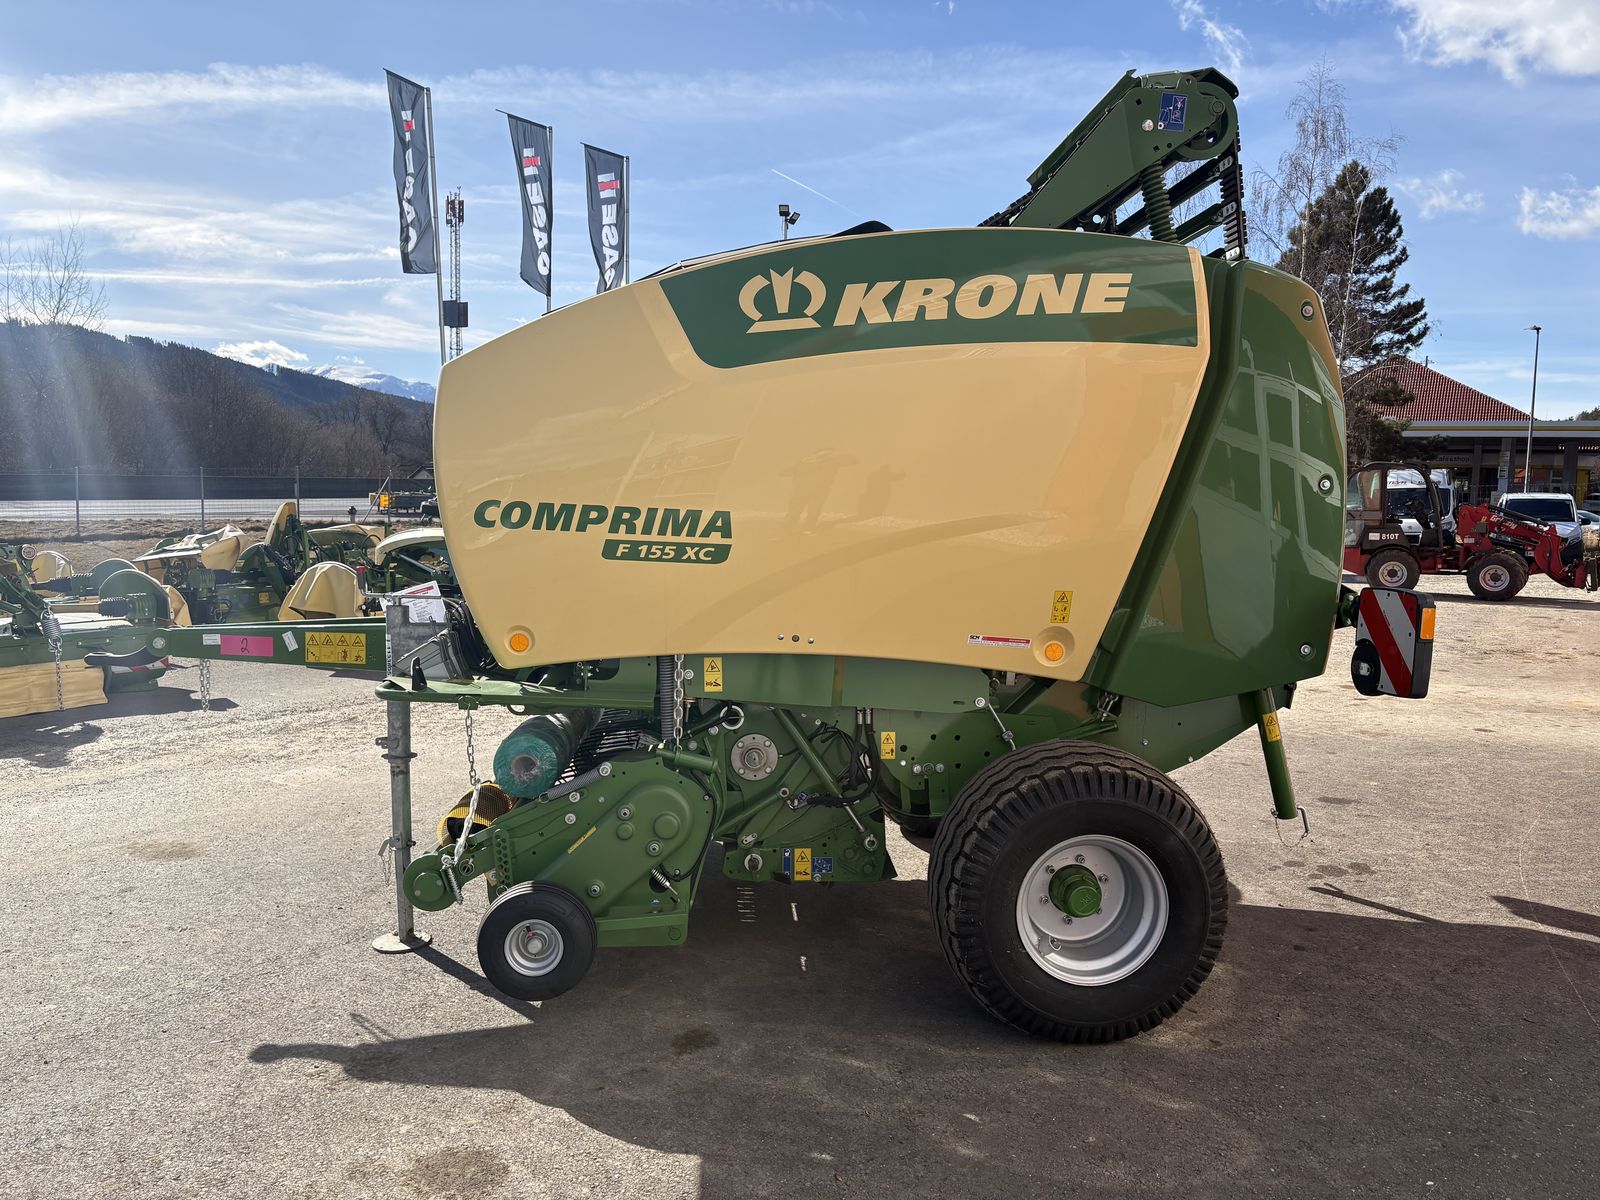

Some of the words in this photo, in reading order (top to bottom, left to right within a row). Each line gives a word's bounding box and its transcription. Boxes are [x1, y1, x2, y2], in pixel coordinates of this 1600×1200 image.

[833, 272, 1133, 327] KRONE
[473, 499, 733, 539] COMPRIMA
[615, 543, 631, 557] F
[638, 544, 676, 560] 155
[681, 546, 715, 561] XC
[240, 637, 250, 654] 2
